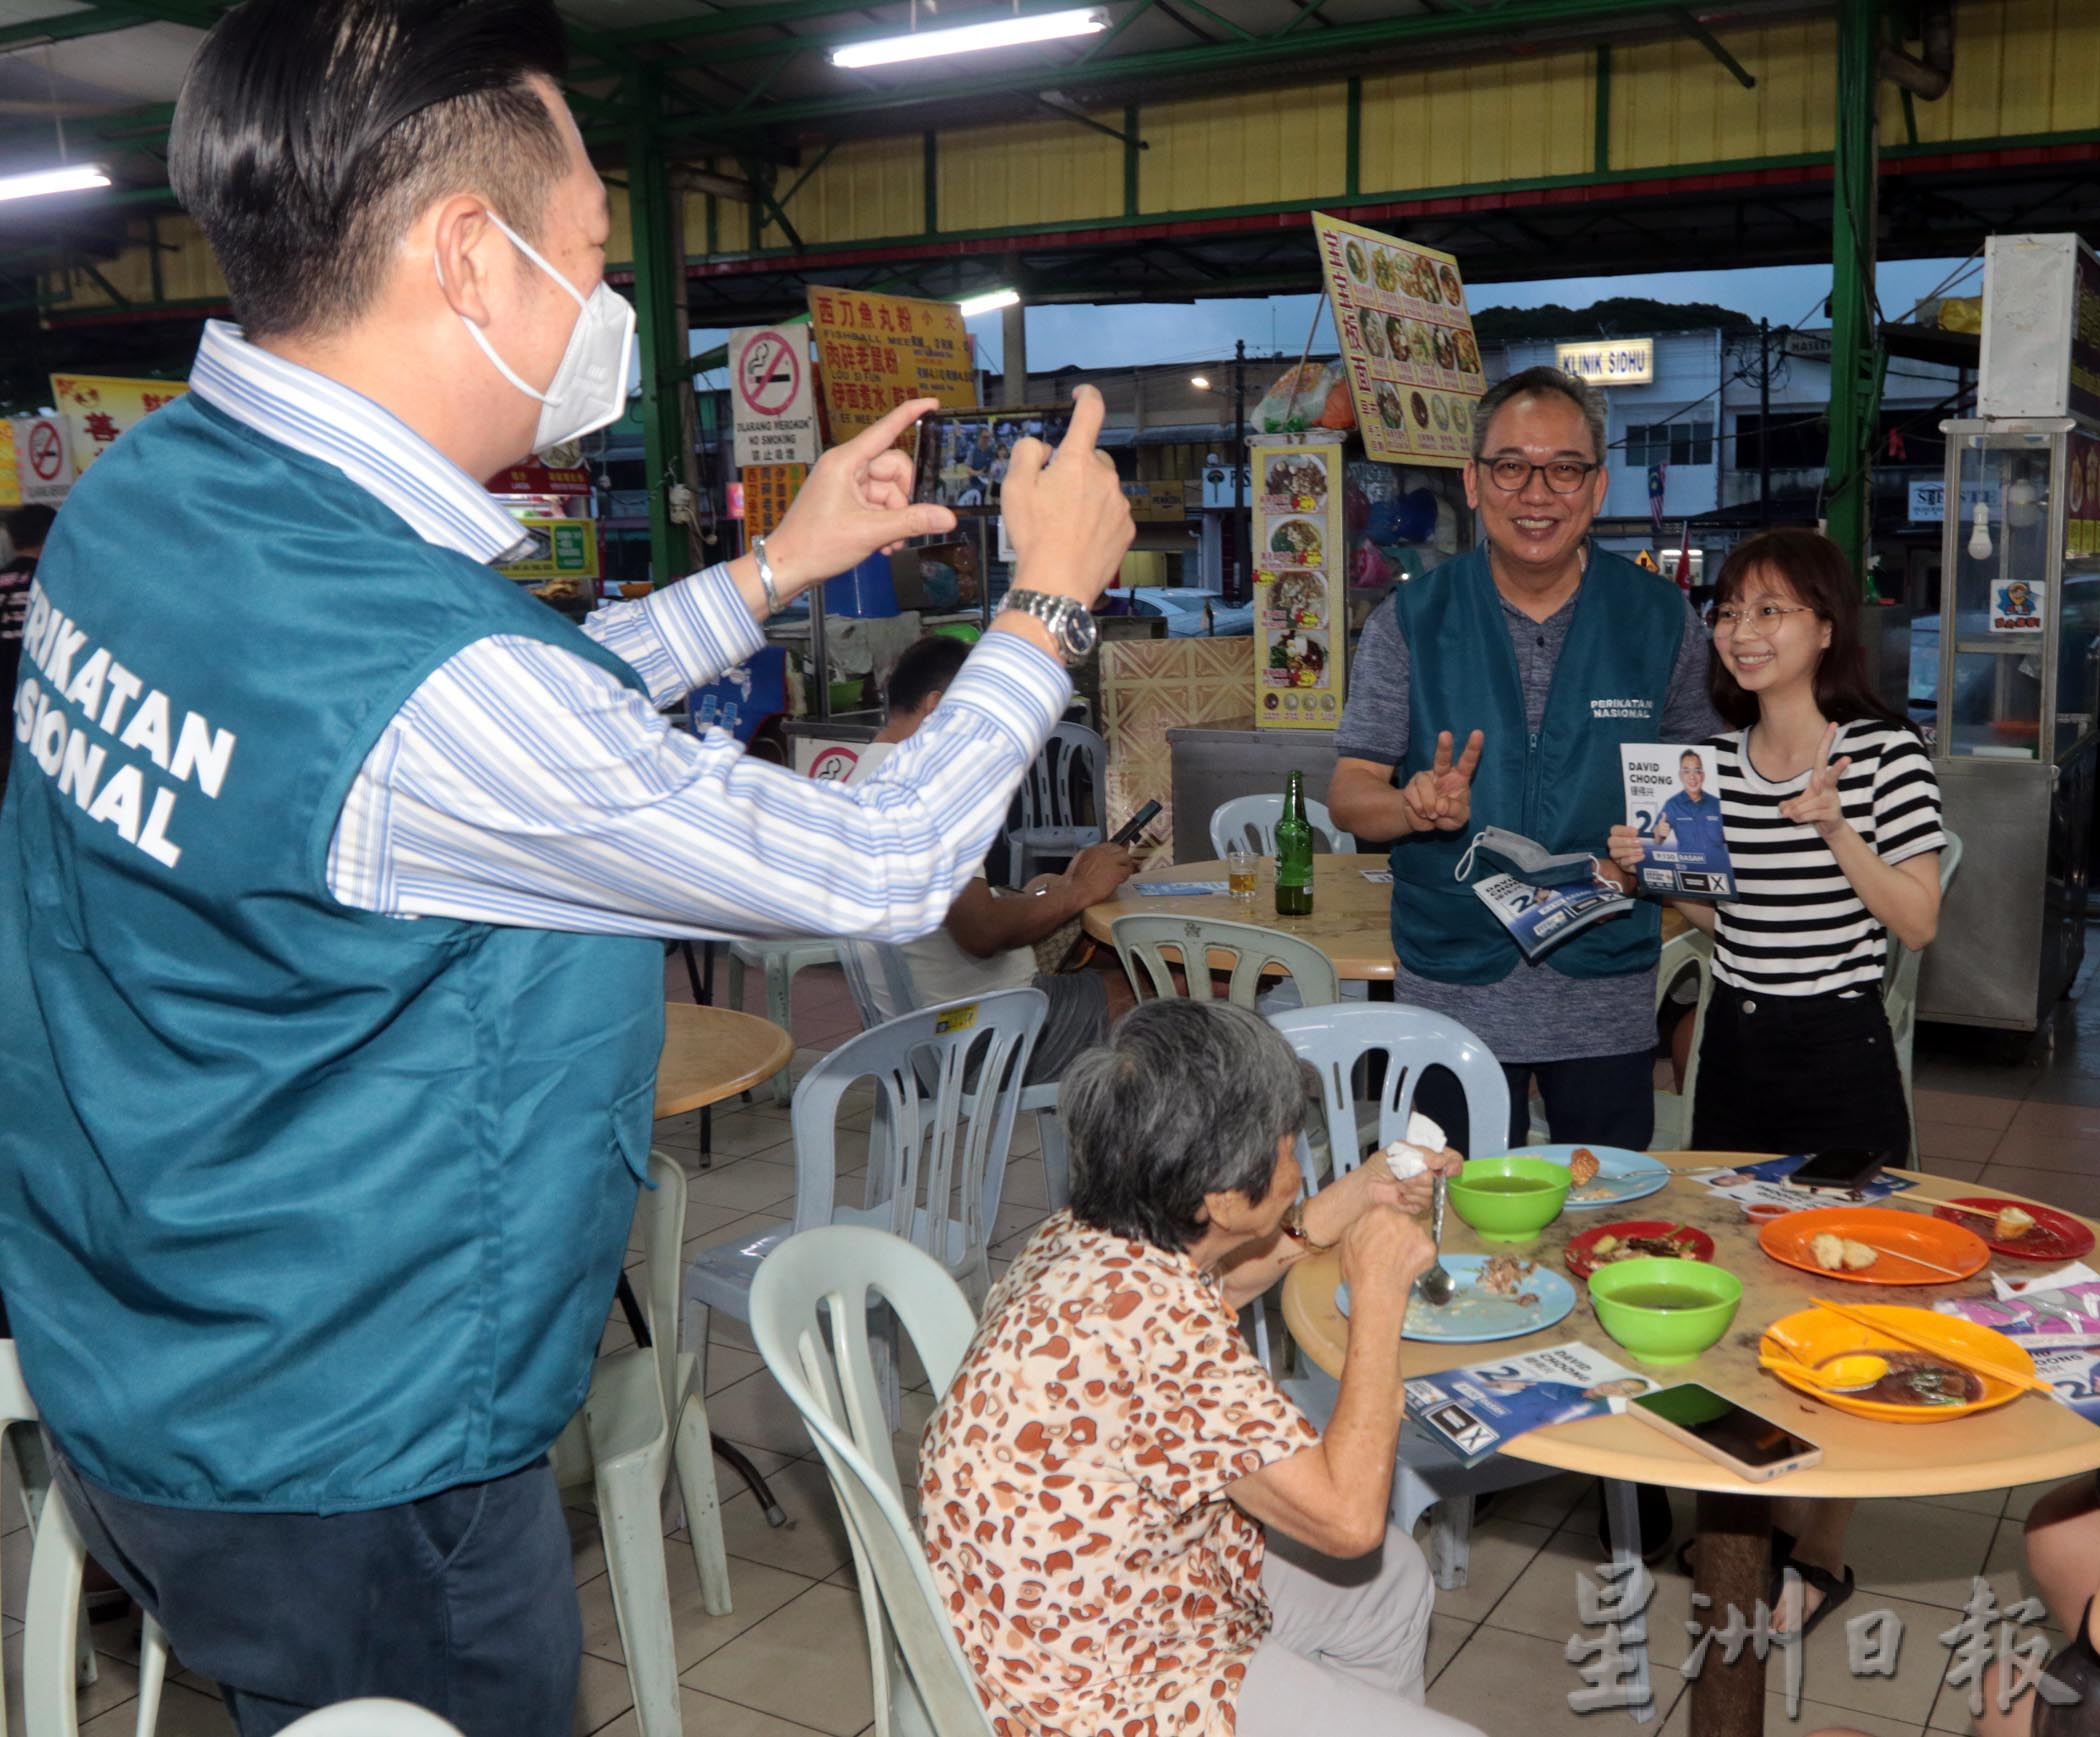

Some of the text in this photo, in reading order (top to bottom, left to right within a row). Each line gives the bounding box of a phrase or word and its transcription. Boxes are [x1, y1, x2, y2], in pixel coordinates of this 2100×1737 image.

[1563, 351, 1645, 375] KLINIK SIDHU
[761, 434, 797, 446] SMOKING
[23, 577, 237, 799] RIKATAN
[1590, 699, 1653, 709] PERIKATAN
[1593, 708, 1651, 718] NASIONAL
[12, 677, 182, 869] SIONAL
[1628, 762, 1660, 772] DAVID
[1629, 774, 1673, 785] CHOONG
[1635, 809, 1656, 839] 2
[1509, 894, 1537, 914] 2
[1539, 1353, 1591, 1382] CHOONG
[1554, 1350, 1593, 1371] DAVID
